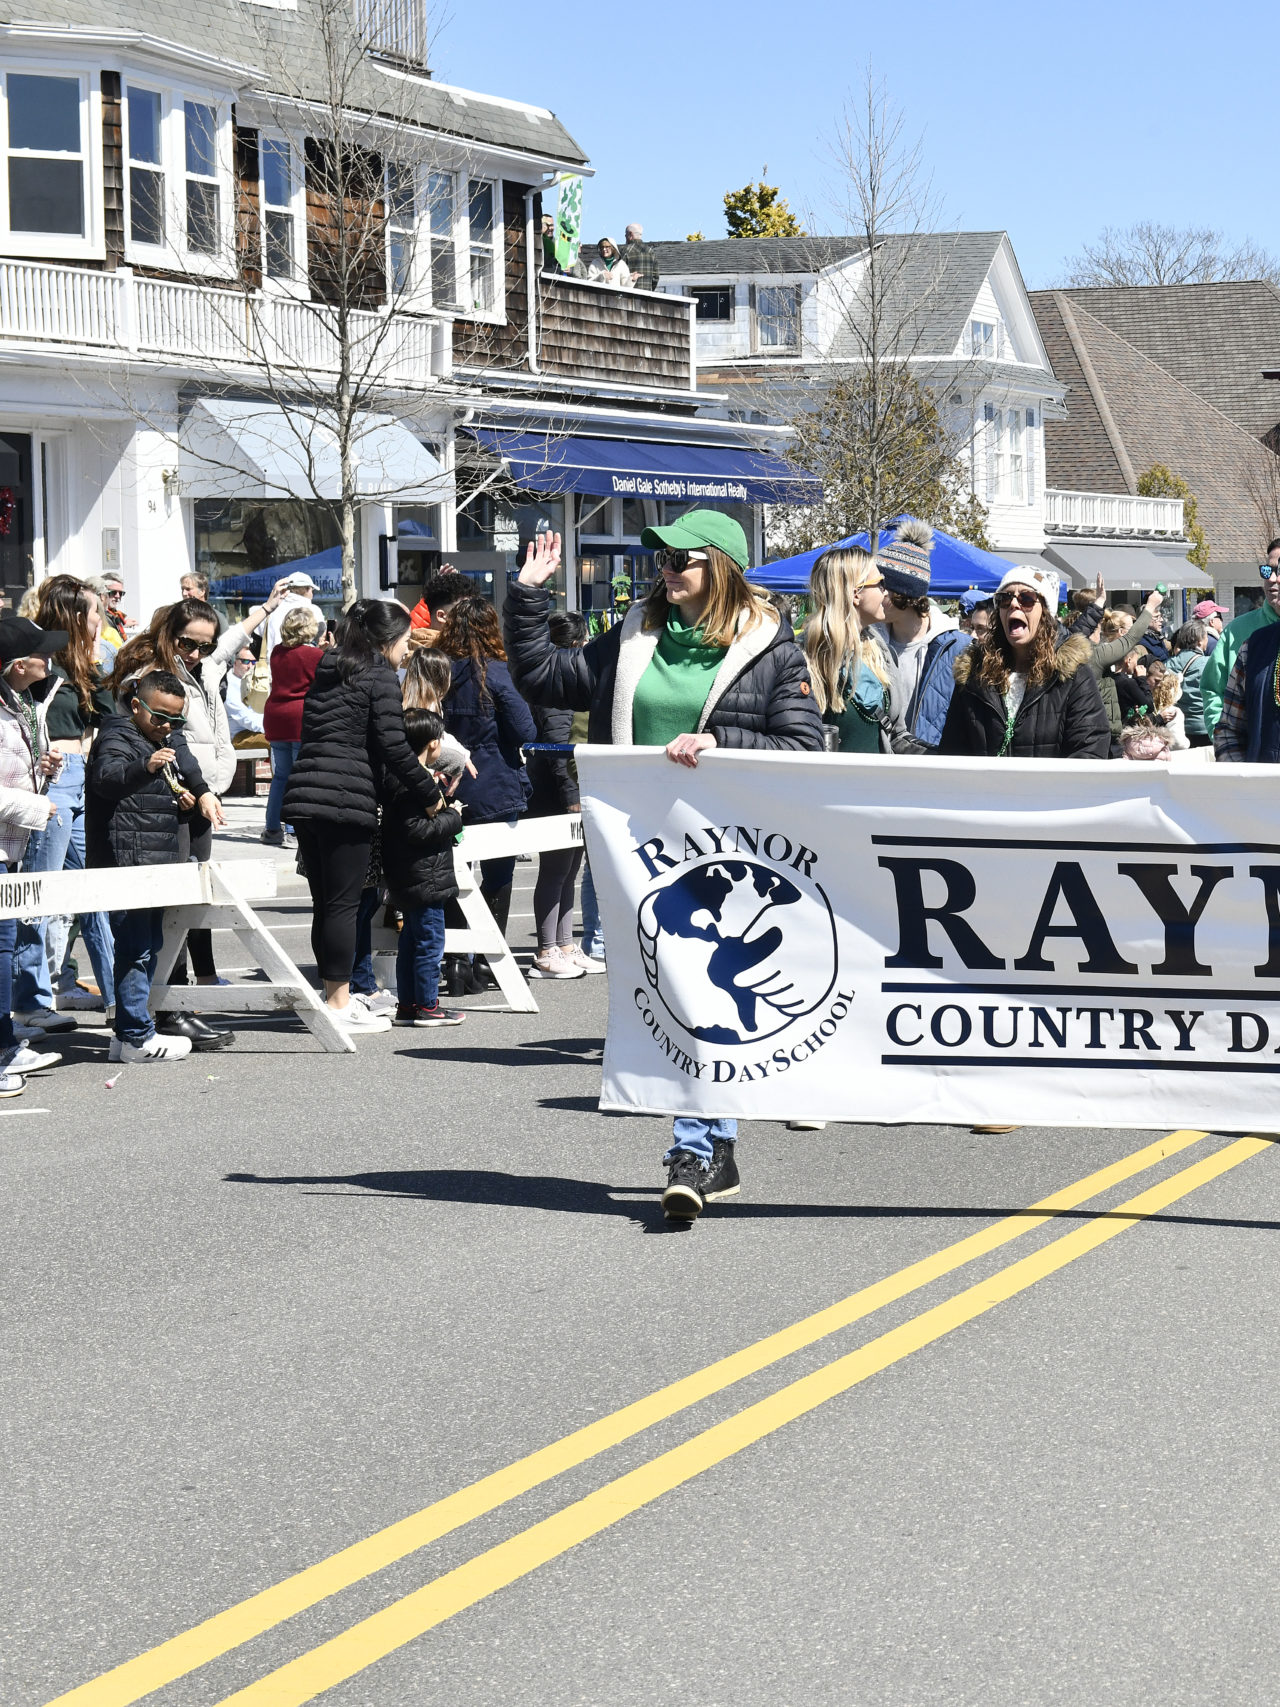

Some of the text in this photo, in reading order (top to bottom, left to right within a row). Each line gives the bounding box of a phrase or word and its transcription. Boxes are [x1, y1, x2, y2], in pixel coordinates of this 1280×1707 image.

[148, 500, 156, 513] 94
[612, 475, 747, 500] Daniel Gale Sotheby's International Realty
[632, 825, 818, 882] RAYNOR
[634, 987, 707, 1080] COUNTRY
[886, 1003, 1204, 1052] COUNTRY
